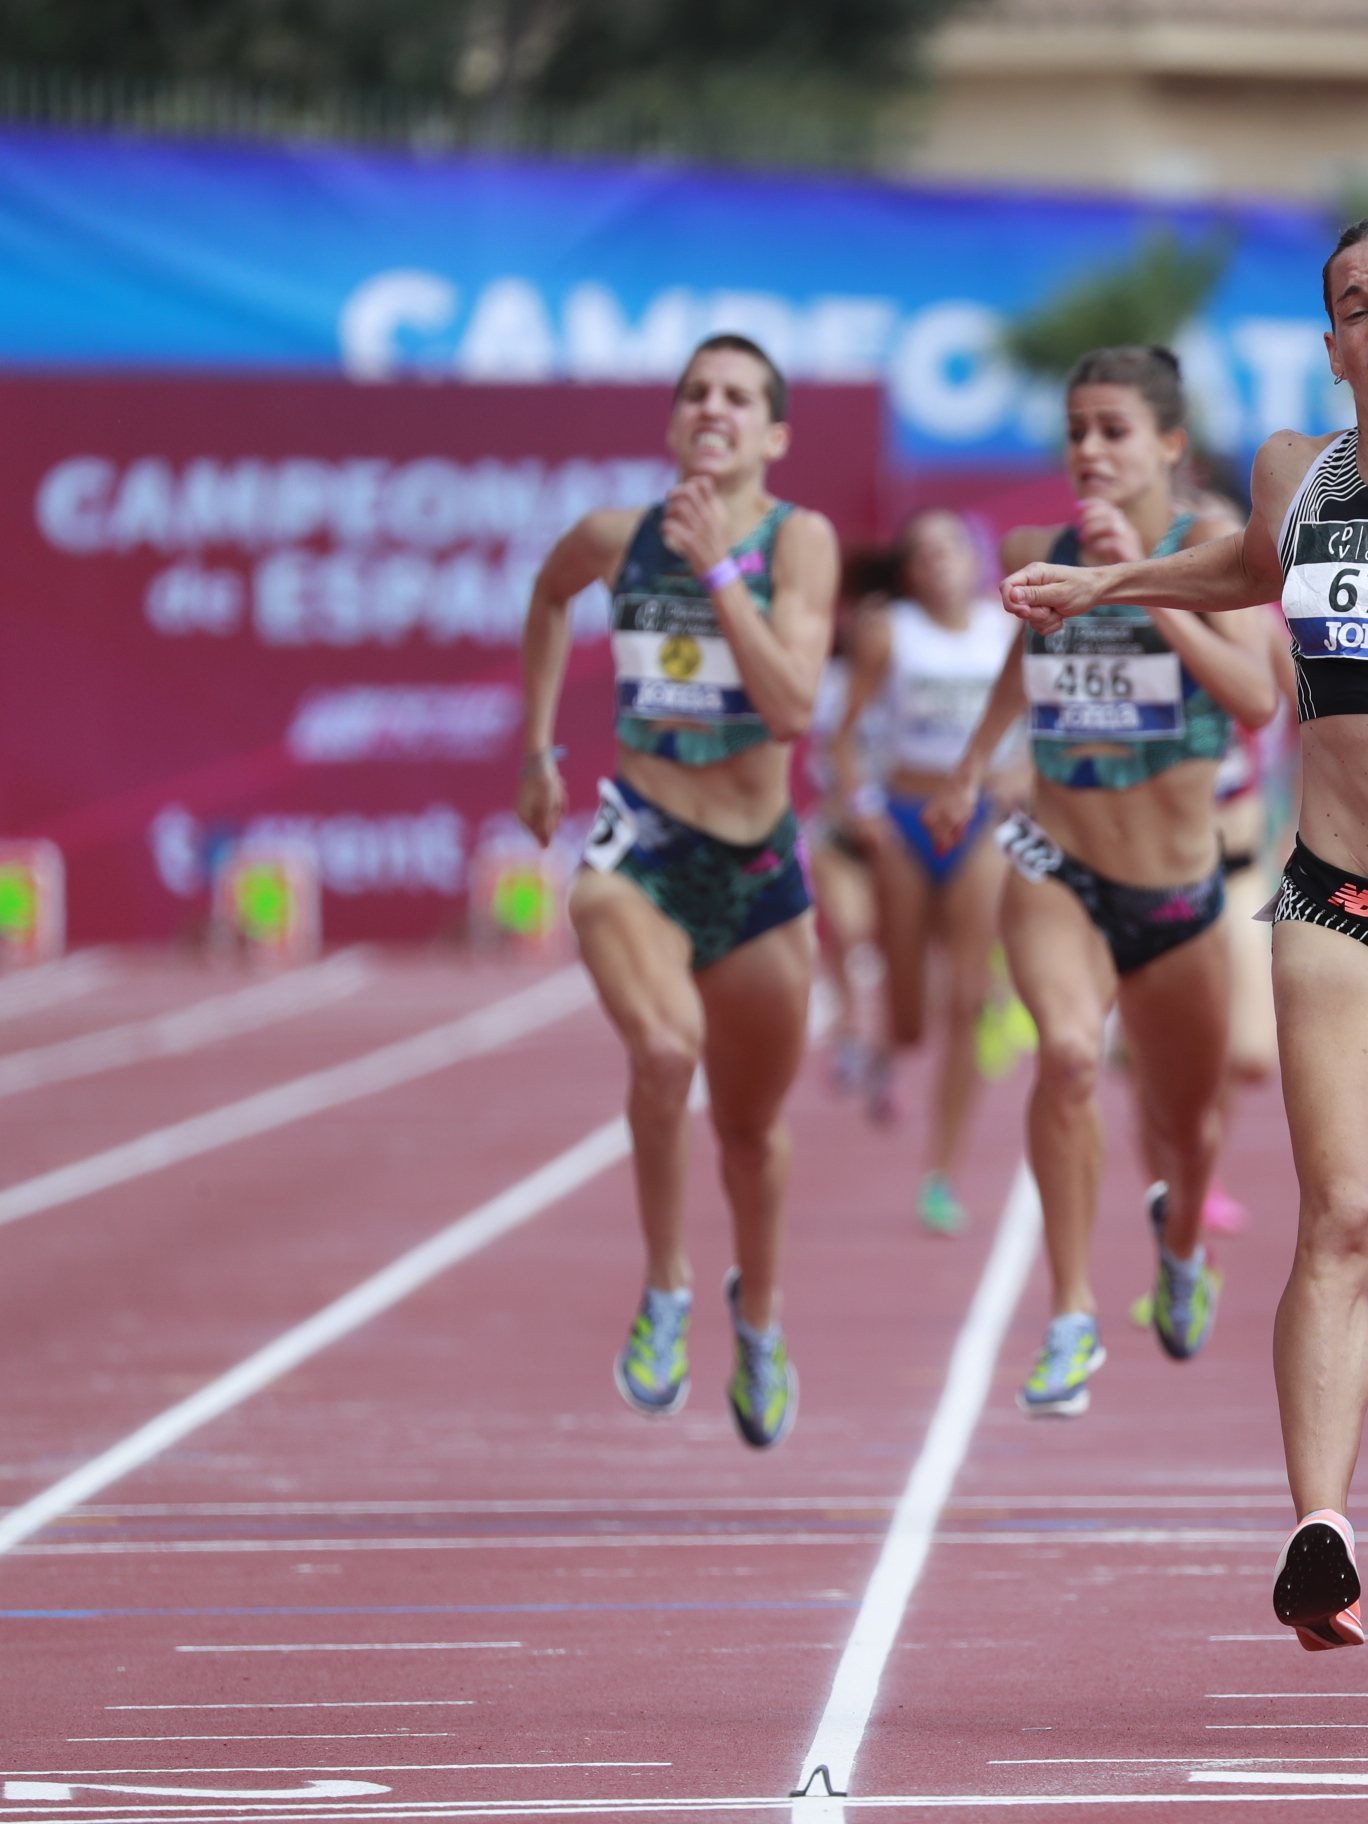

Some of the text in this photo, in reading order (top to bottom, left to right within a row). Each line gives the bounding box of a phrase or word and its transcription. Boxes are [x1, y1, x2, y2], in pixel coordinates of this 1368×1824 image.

[36, 455, 674, 553] CAMPEONAT
[145, 563, 244, 637] de
[251, 547, 612, 645] ESPA
[1054, 661, 1134, 698] 466
